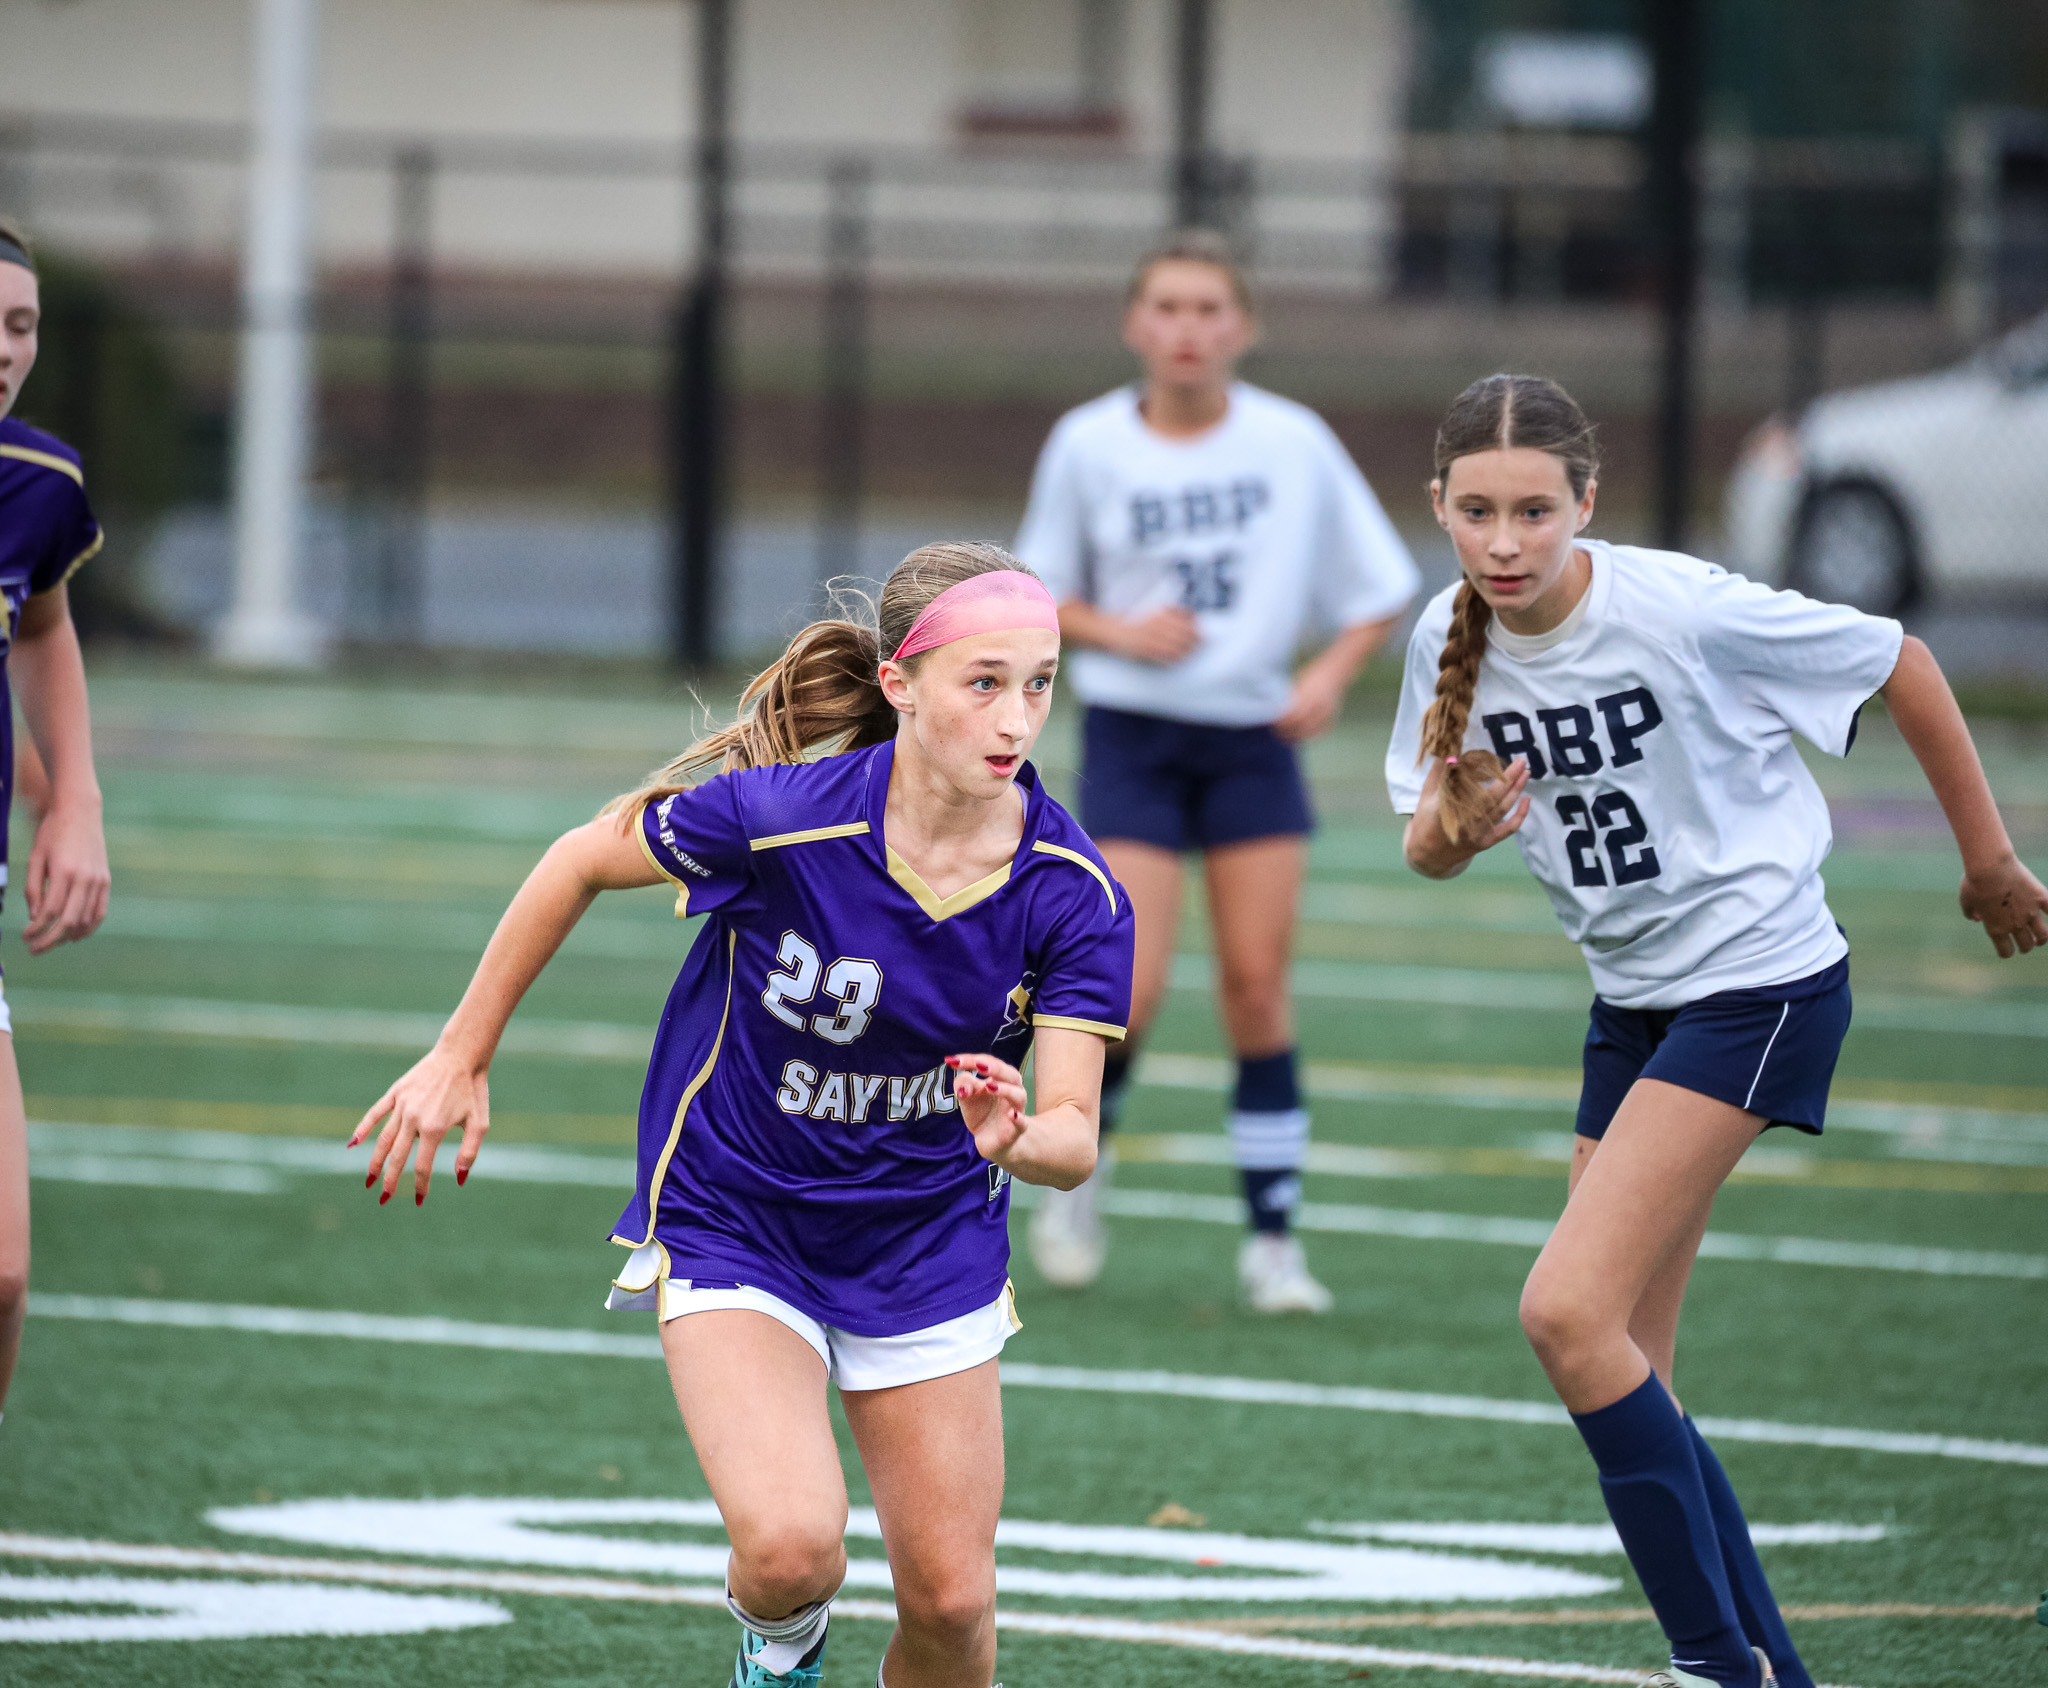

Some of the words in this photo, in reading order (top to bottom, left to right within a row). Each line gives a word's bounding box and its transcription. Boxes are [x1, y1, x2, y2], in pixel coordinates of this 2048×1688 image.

[1481, 687, 1664, 781] BBP
[660, 828, 713, 878] FLASHES
[1554, 790, 1662, 888] 22
[761, 929, 883, 1045] 23
[777, 1059, 970, 1123] SAYVIL
